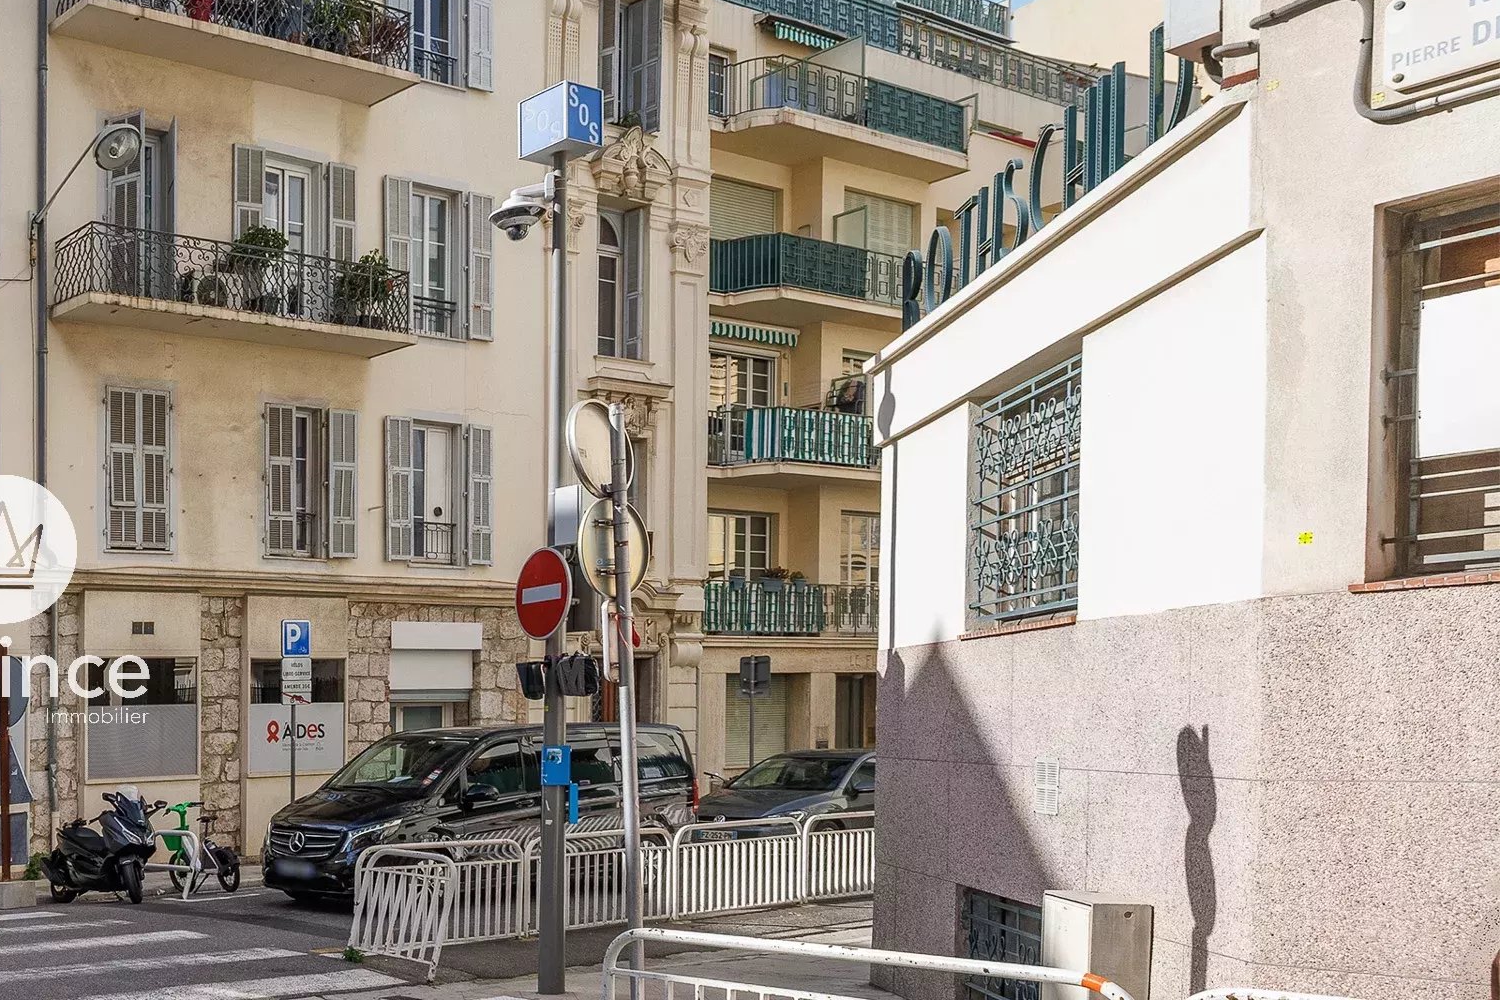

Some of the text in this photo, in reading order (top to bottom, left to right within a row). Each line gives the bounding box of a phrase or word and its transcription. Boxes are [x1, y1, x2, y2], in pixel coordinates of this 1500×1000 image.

[1391, 15, 1500, 71] PIERRE D
[569, 85, 600, 144] SOS
[286, 623, 301, 650] P
